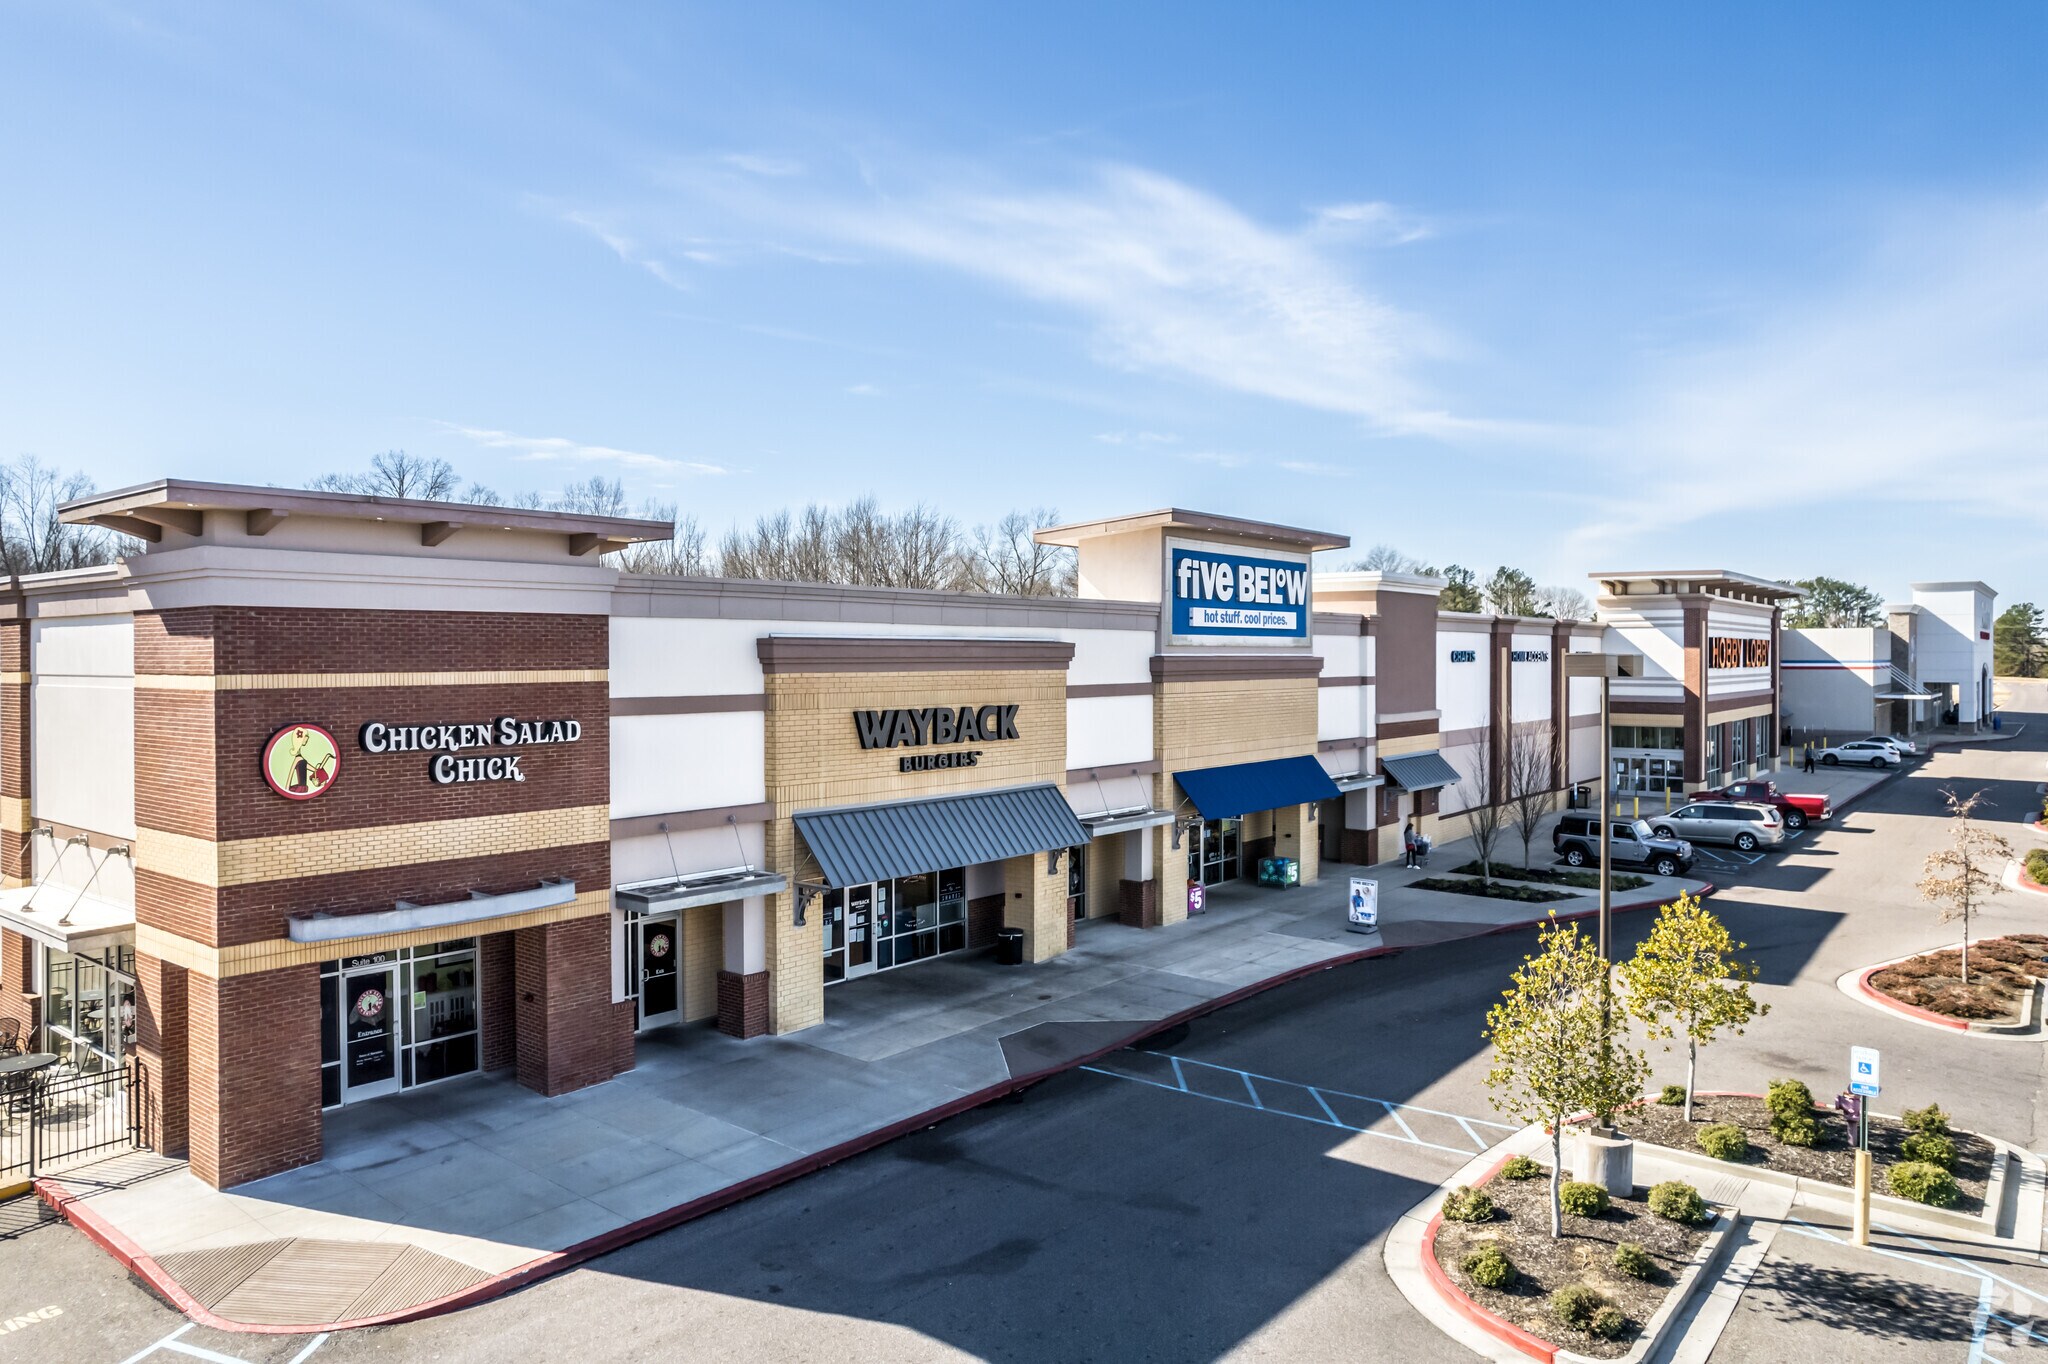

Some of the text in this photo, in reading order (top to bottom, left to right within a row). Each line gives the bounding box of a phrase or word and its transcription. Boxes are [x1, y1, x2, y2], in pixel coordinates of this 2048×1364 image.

[1178, 558, 1307, 605] five BELOW
[1204, 609, 1288, 627] hot stuff. cool prices.
[1451, 650, 1476, 662] CRAFTS
[1709, 637, 1769, 668] HOBBY LOBBY
[361, 717, 581, 753] CHICKEN SALAD
[853, 704, 1020, 749] WAYBACK
[432, 754, 526, 784] CHICK
[900, 752, 978, 772] BURGERS
[1288, 864, 1298, 882] $5
[1190, 890, 1203, 909] $5
[351, 954, 386, 968] Suite 100
[357, 1028, 383, 1038] Entrance
